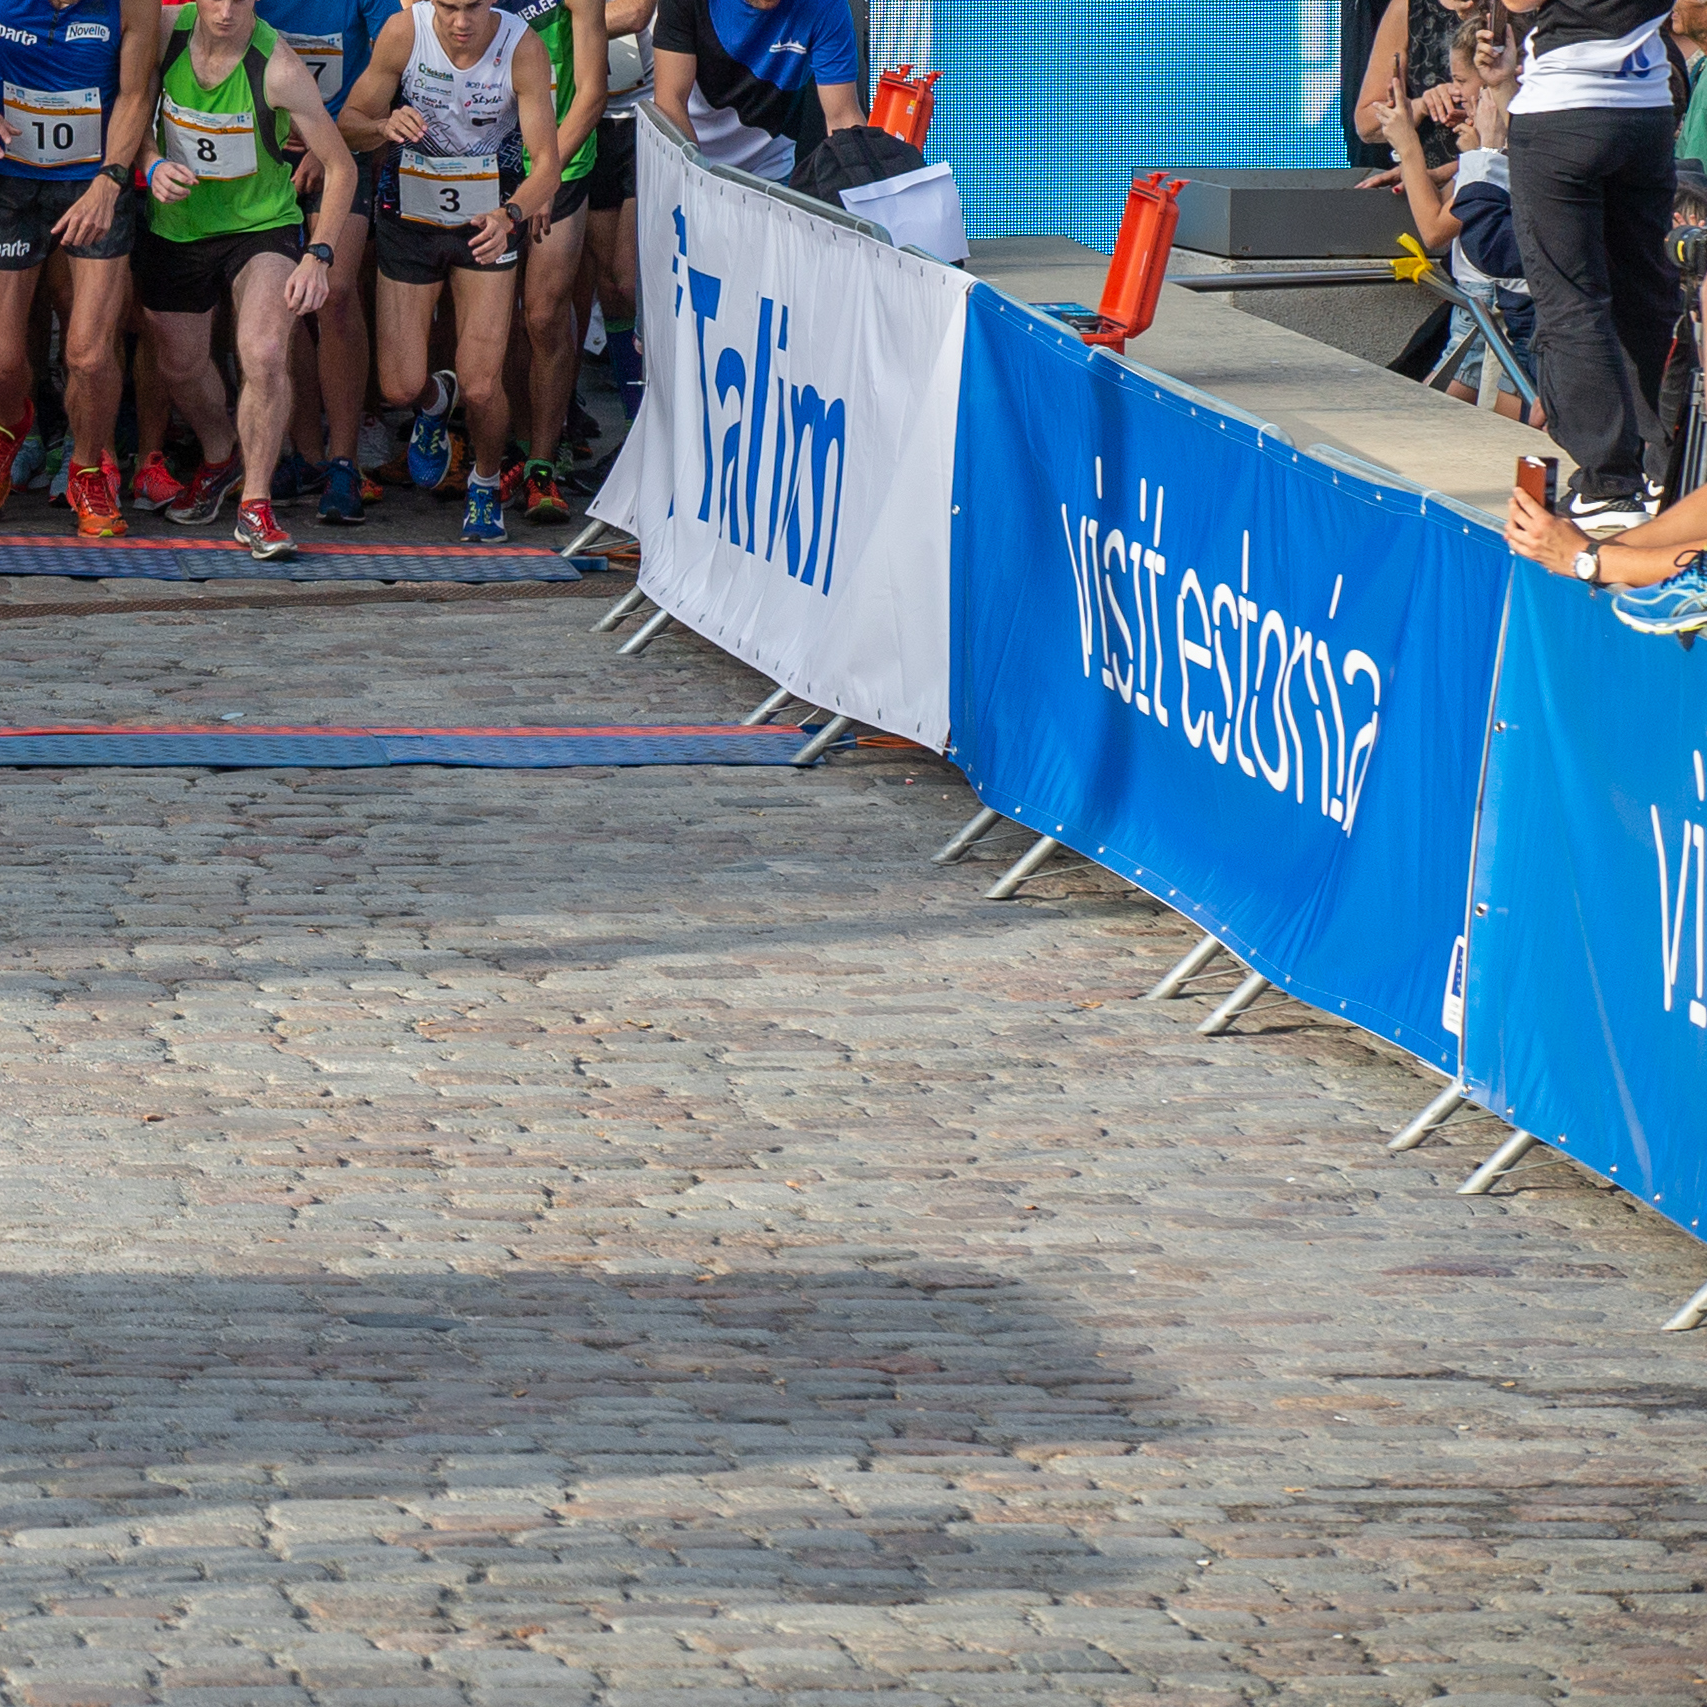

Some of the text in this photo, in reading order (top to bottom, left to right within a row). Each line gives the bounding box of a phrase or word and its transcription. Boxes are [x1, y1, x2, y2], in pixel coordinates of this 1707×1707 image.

[69, 24, 107, 40] Novelle
[31, 121, 74, 150] 10
[197, 137, 217, 163] 8
[439, 187, 461, 213] 3
[1061, 456, 1381, 835] visit estonia
